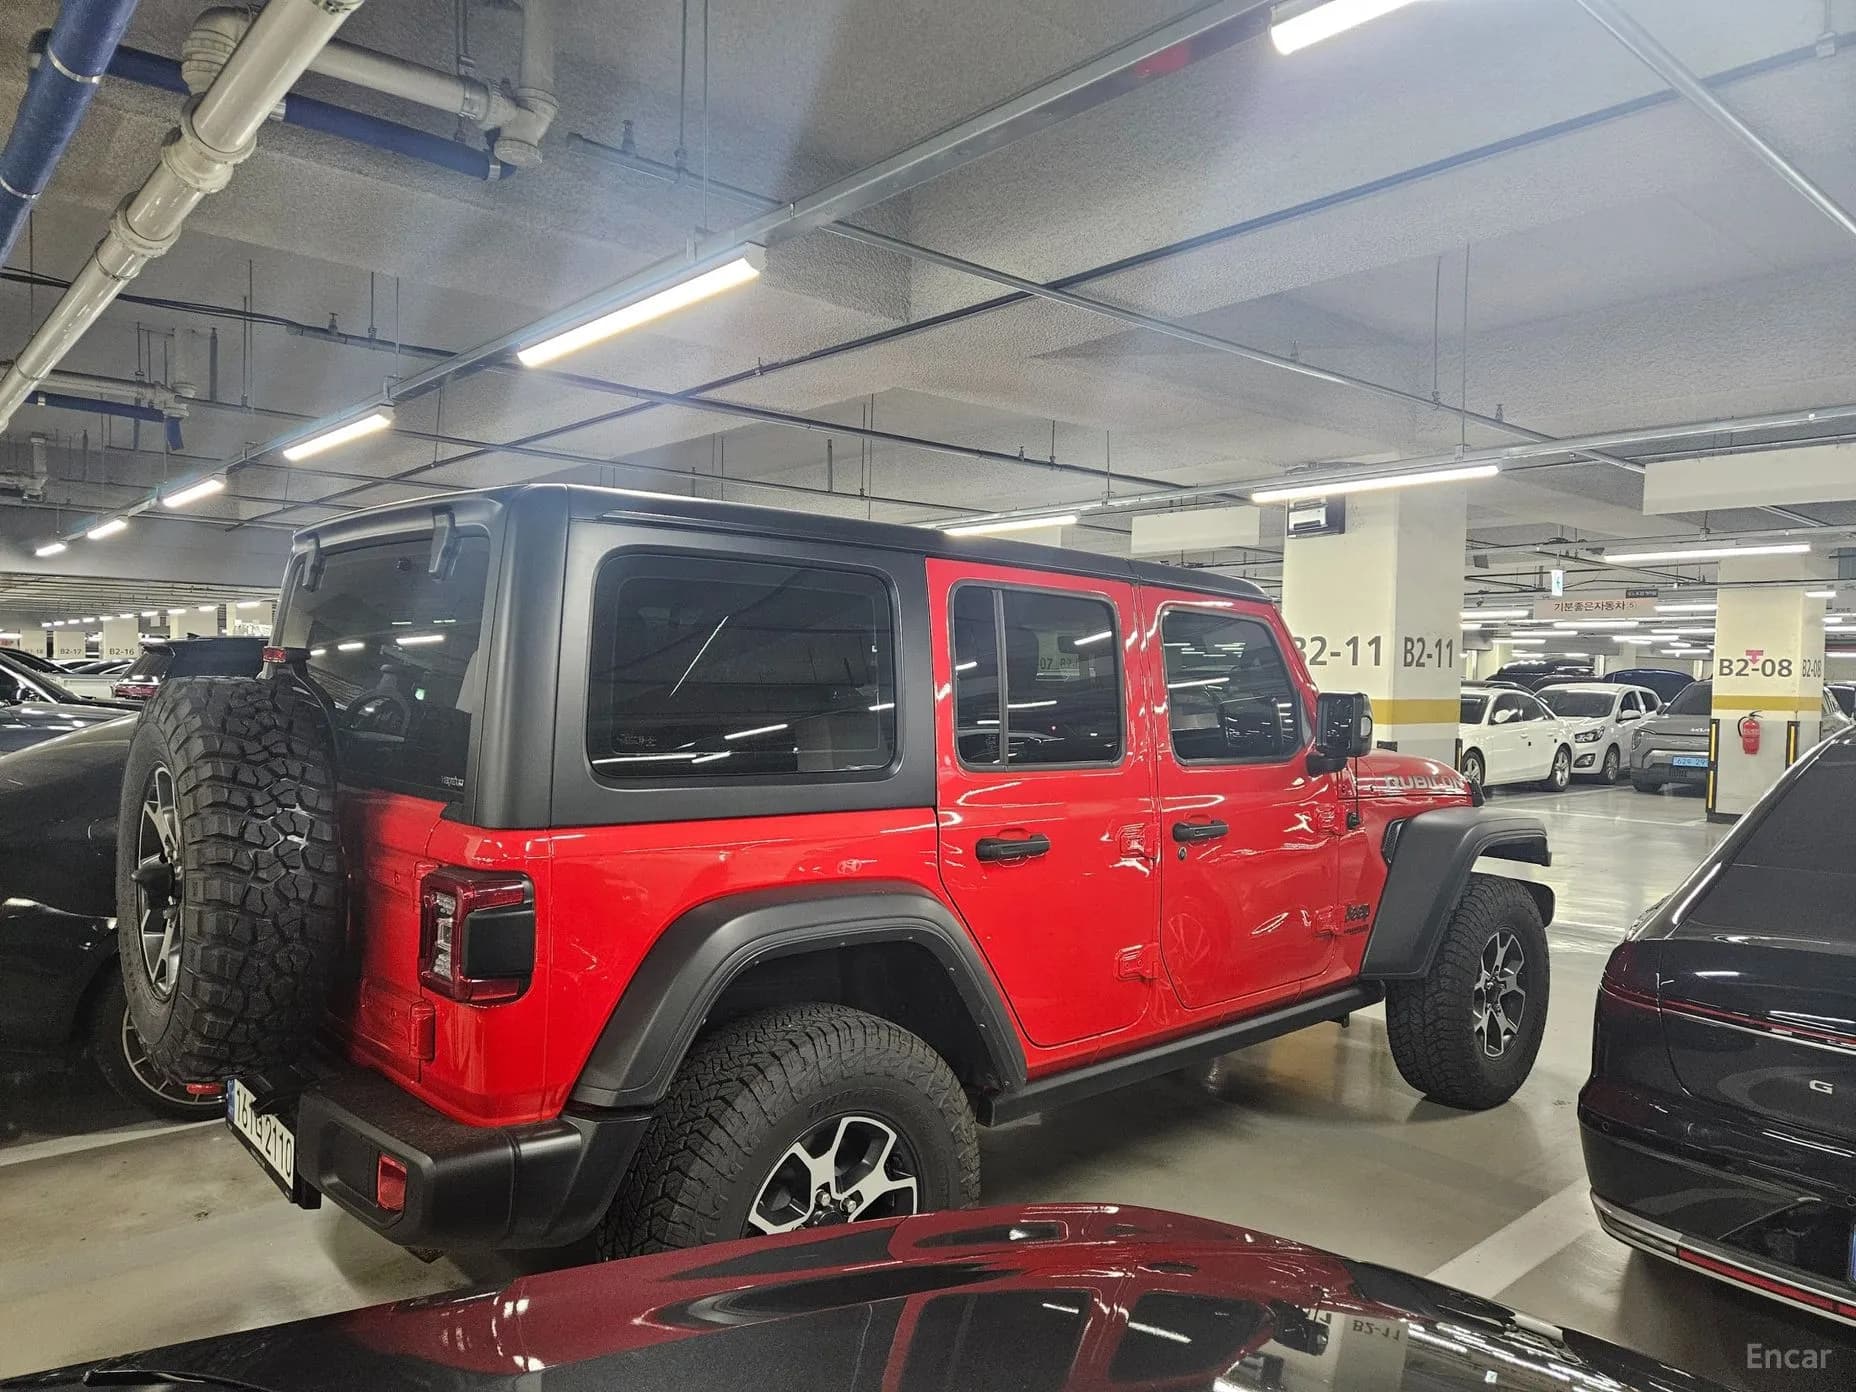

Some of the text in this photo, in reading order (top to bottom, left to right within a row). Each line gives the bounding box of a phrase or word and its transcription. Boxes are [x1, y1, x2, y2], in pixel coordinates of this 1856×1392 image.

[109, 648, 135, 656] B2-16
[1403, 636, 1453, 668] B2-11
[1719, 658, 1793, 678] B2-08
[1802, 659, 1822, 678] B2-08
